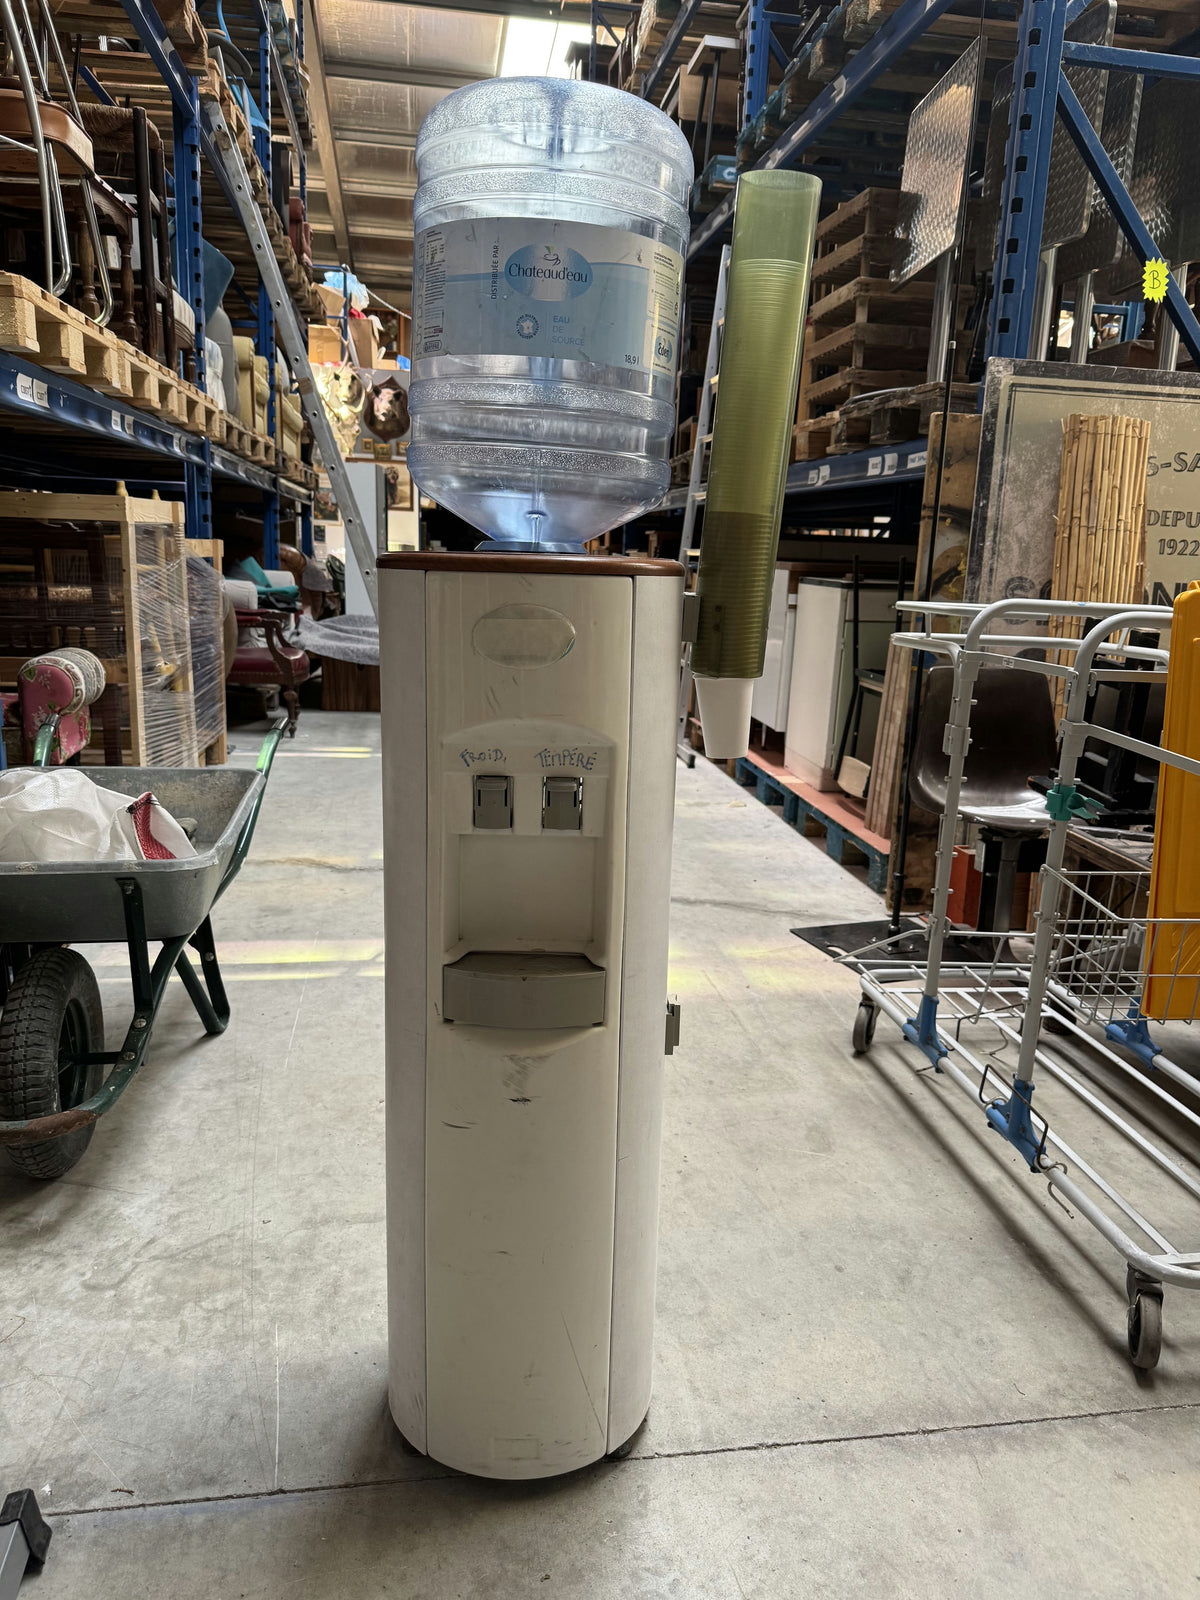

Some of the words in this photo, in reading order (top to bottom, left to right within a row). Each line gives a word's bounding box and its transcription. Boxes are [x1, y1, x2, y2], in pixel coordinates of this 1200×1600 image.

[492, 245, 500, 258] PAR
[490, 259, 499, 300] DISTRIBUÉE
[508, 262, 588, 283] Chateaud'eau
[1148, 270, 1162, 290] B
[552, 315, 570, 324] EAU
[551, 335, 585, 346] SOURCE
[624, 354, 636, 366] 18,9
[1158, 538, 1200, 557] 1922
